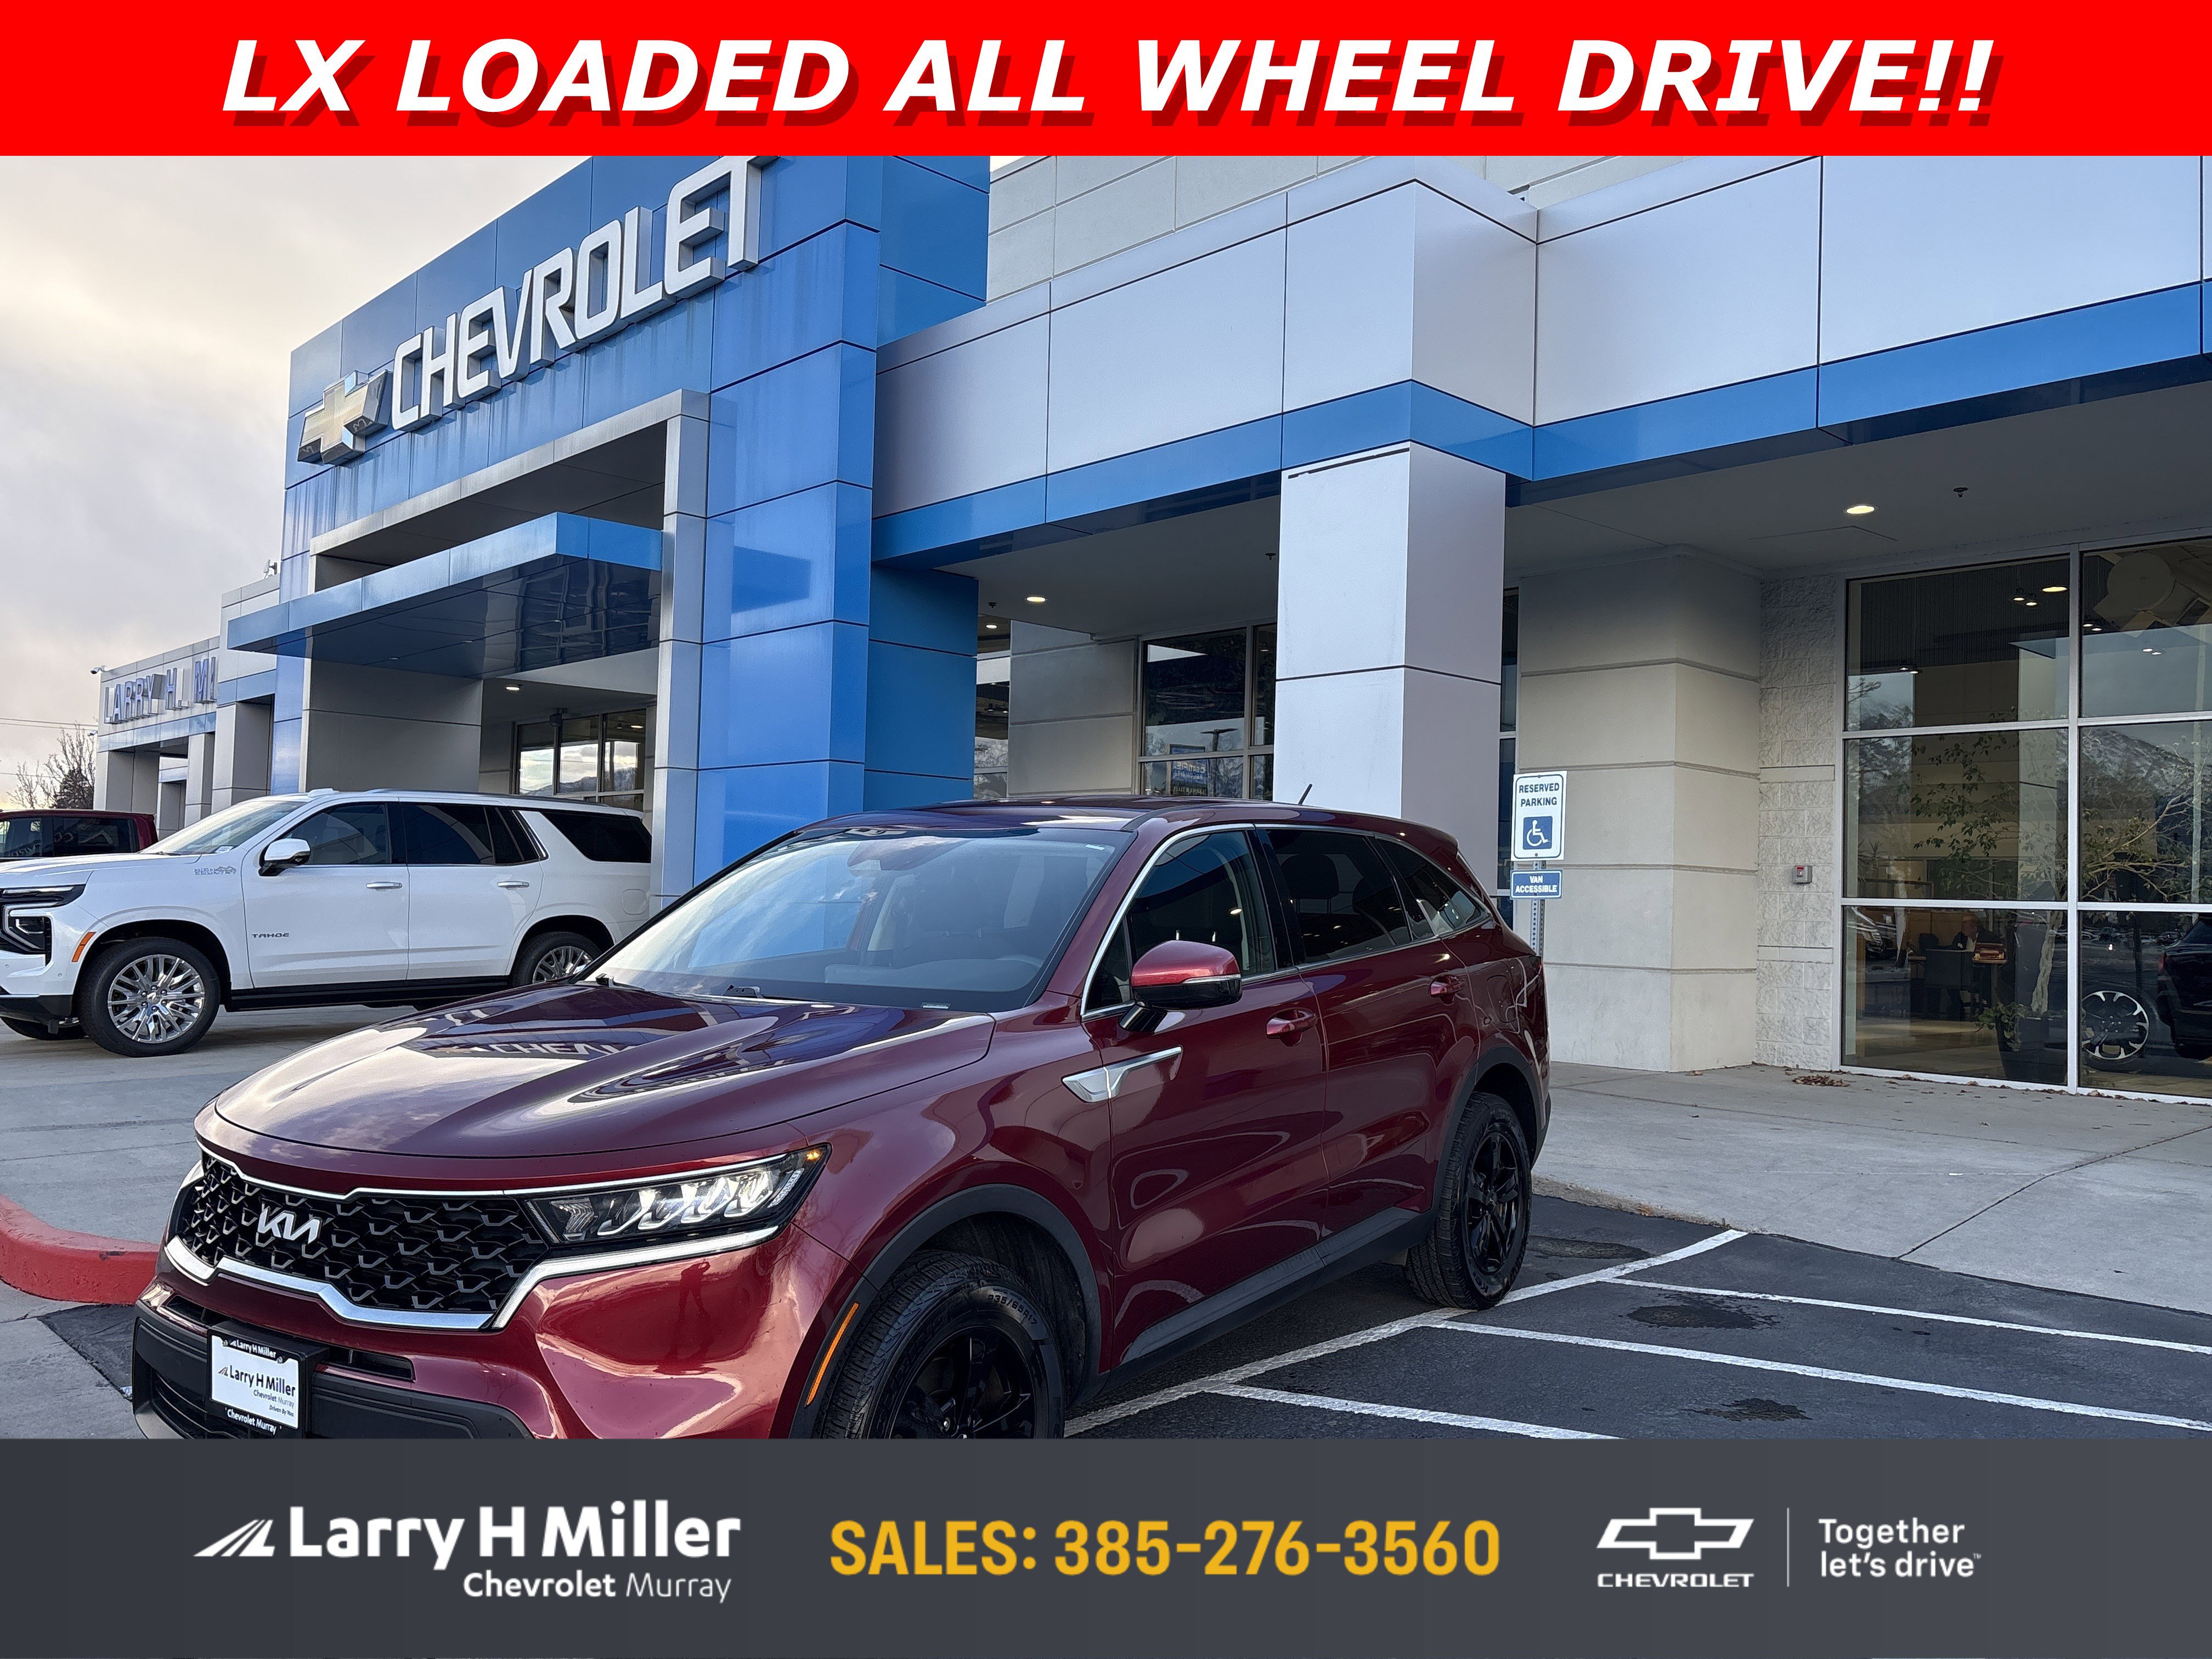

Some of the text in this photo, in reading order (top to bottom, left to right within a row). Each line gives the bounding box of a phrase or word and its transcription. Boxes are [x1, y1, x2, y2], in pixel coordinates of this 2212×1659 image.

[392, 156, 767, 431] CHEVROLET
[104, 674, 159, 724] LARRY
[1519, 782, 1560, 794] RESERVED
[1520, 797, 1558, 808] PARKING
[1515, 884, 1558, 894] ACCESSIBLE
[1529, 875, 1543, 884] VAN
[236, 1339, 276, 1358] Larry H Miller
[229, 1364, 296, 1397] Larry H Miller
[253, 1389, 295, 1409] Chevrolet Murray
[227, 1408, 277, 1436] Chevrolet Murray
